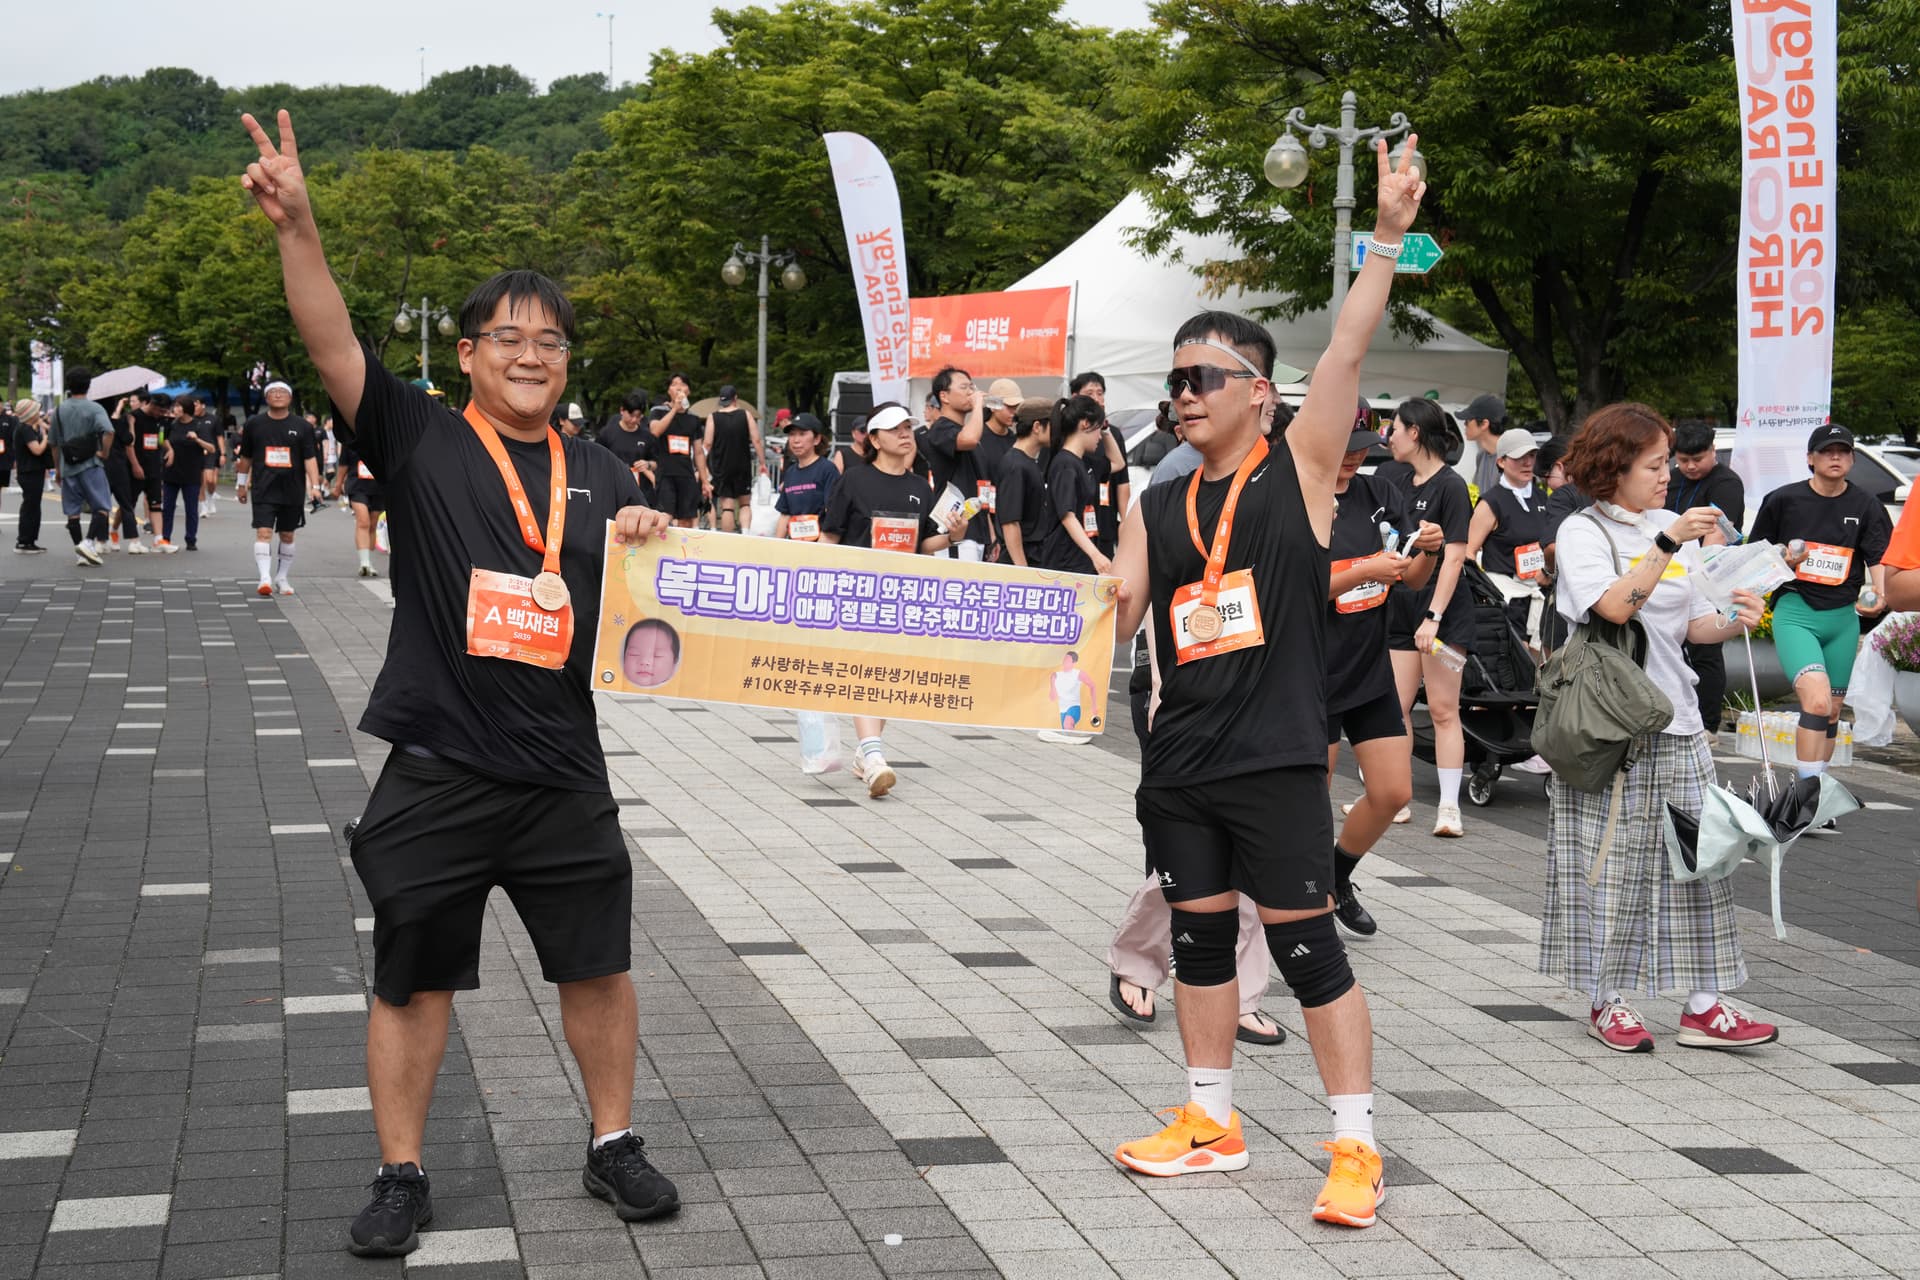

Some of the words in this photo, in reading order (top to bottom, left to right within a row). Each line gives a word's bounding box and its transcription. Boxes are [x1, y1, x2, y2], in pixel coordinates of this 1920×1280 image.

[964, 316, 1010, 352] 의료본부
[657, 560, 790, 616] 복근아!
[797, 571, 876, 599] 아빠한테
[880, 576, 939, 603] 와줘서
[1006, 586, 1071, 613] 고맙다!
[483, 605, 503, 626] A
[506, 607, 560, 637] 백재현
[795, 598, 835, 621] 아빠
[840, 601, 898, 626] 정말로
[904, 604, 989, 633] 완주했다!
[994, 611, 1075, 638] 사랑한다!
[750, 655, 972, 690] #사랑하는복근이#탄생기념마라톤
[742, 676, 974, 711] #10K완주#우리곧만나자#사랑한다
